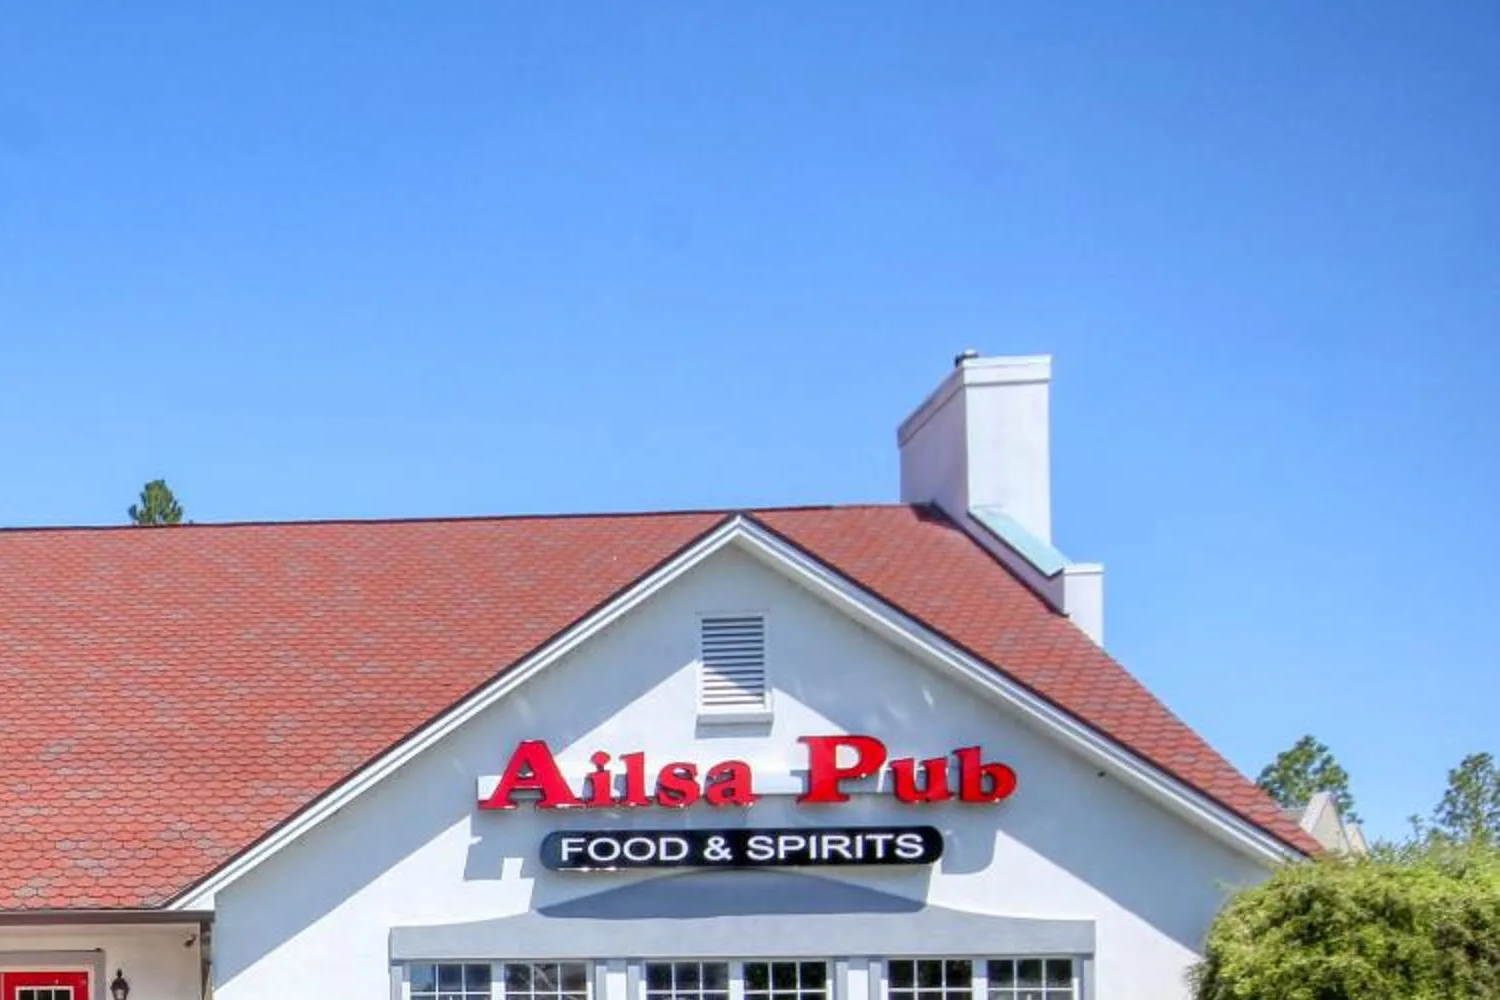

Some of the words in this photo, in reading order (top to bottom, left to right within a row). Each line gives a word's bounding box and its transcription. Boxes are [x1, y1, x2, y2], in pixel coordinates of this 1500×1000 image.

[477, 739, 762, 810] Ailsa
[795, 735, 1018, 804] Pub
[561, 837, 688, 862] FOOD
[703, 836, 732, 860] &
[747, 833, 925, 860] SPIRITS
